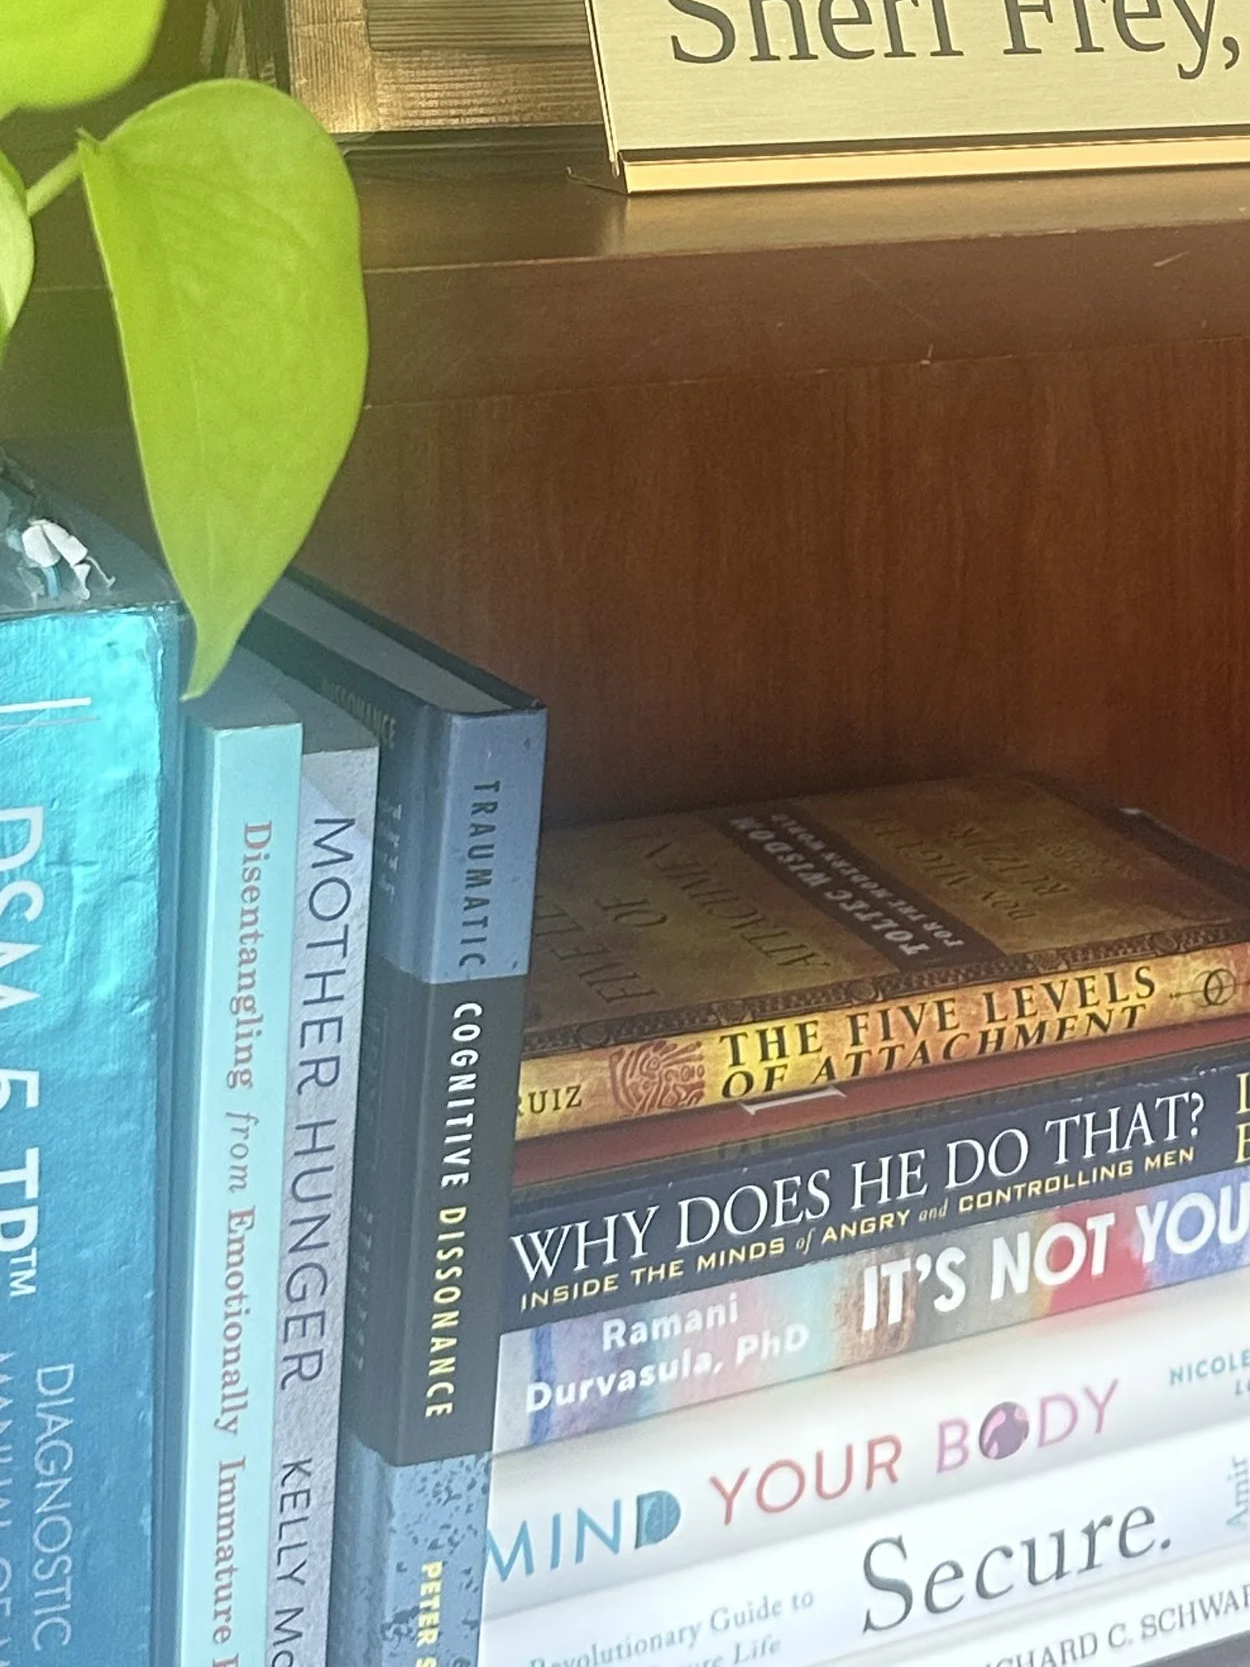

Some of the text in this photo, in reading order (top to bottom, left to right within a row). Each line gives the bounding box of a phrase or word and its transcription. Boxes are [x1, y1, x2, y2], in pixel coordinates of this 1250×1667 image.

[458, 778, 500, 968] TRAUMATIC
[730, 816, 930, 956] TOLTEC WISDOM
[226, 820, 272, 1091] Disentangling
[921, 921, 965, 948] FOR
[719, 965, 1157, 1068] THE FIVE LEVELS
[720, 1002, 1147, 1099] OF ATTACHMENT
[225, 1111, 260, 1195] from
[281, 818, 355, 1391] MOTHER HUNGER
[518, 1085, 583, 1116] UIZ
[425, 1001, 483, 1418] COGNITIVE DISSONANCE
[509, 1091, 1206, 1283] WHY DOES HE DO THAT?
[520, 1146, 1196, 1313] INSIDE THE MINDS of ANGRY and CONTROLLING MEN
[989, 1212, 1117, 1302] NOT
[213, 1205, 256, 1436] Emotionally
[525, 1323, 811, 1414] Durvasula, PhD
[602, 1291, 739, 1352] Ramani
[32, 1363, 75, 1652] DIAGNOSTIC
[276, 1458, 312, 1586] KELLY
[485, 1378, 1120, 1583] MIND YOUR BODY
[1225, 1453, 1250, 1530] Amir
[212, 1455, 246, 1645] Immature
[416, 1560, 443, 1647] PETER
[861, 1503, 1173, 1635] Secure.
[709, 1596, 784, 1632] Guide
[792, 1590, 815, 1611] to
[733, 1634, 782, 1666] Life
[1107, 1622, 1135, 1649] C.
